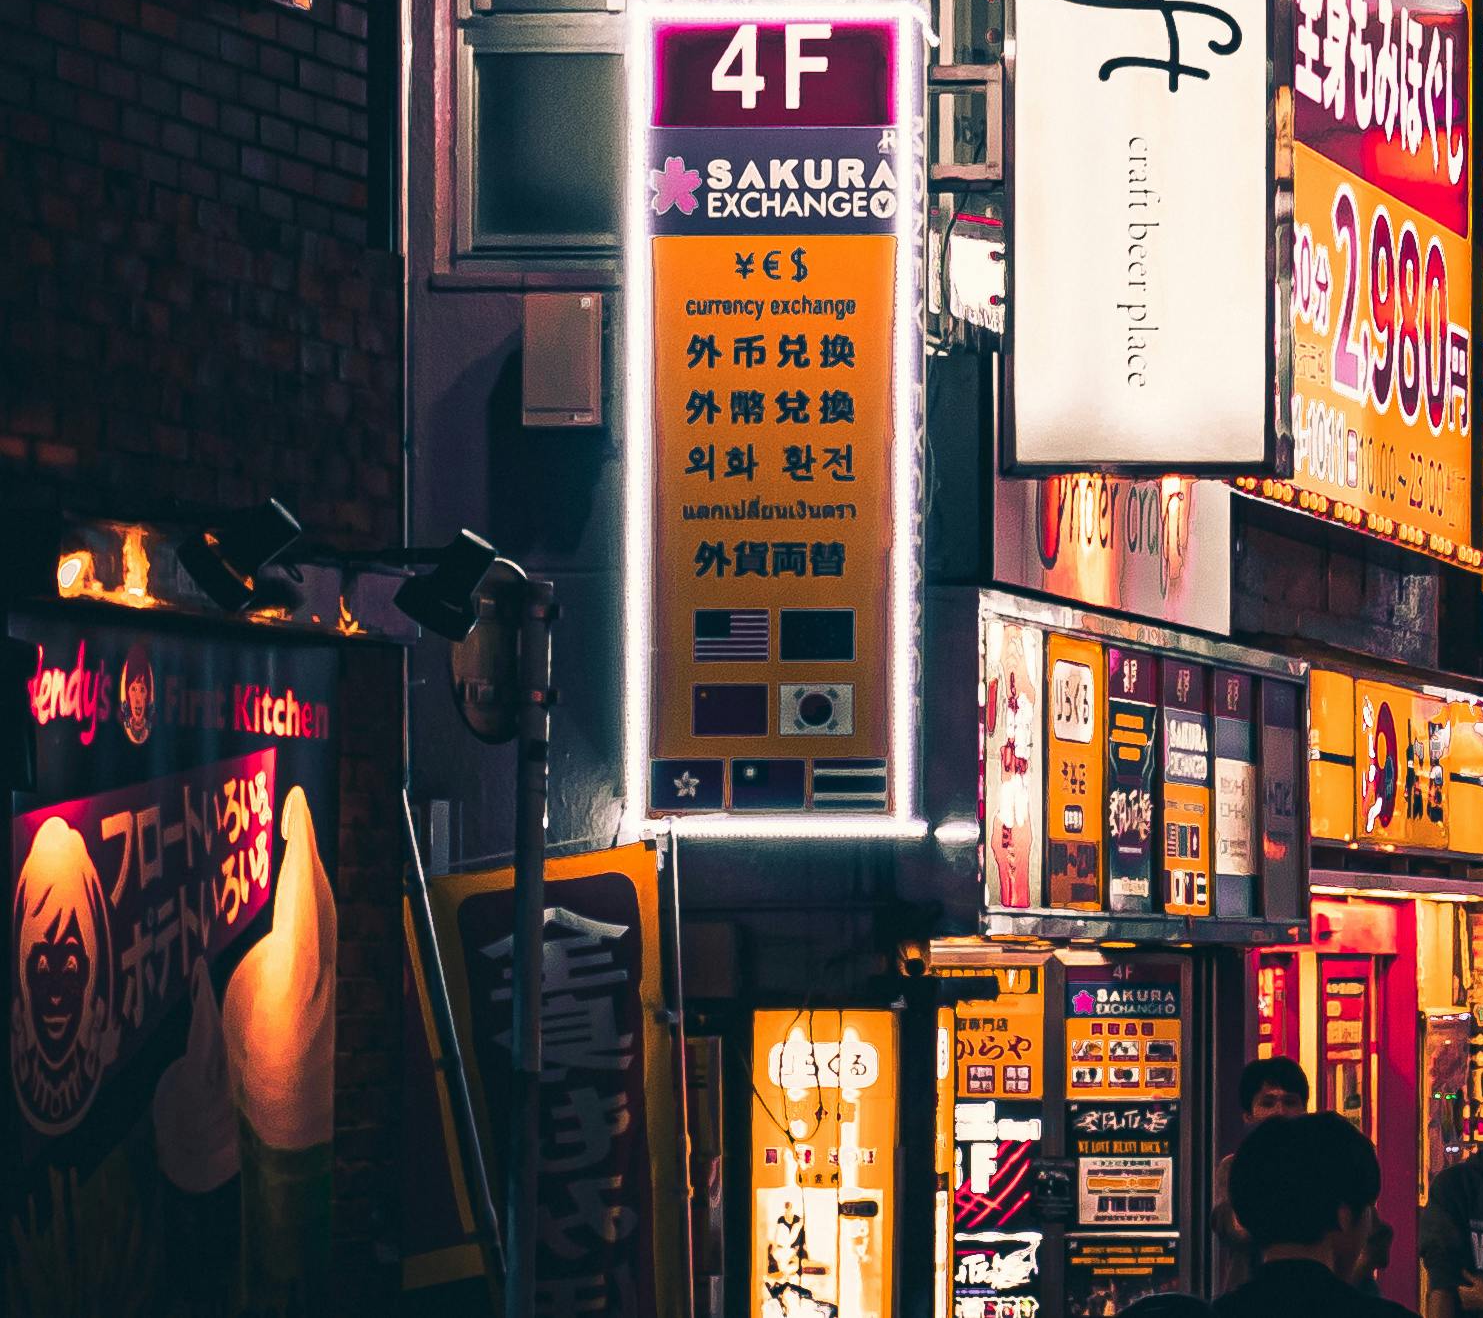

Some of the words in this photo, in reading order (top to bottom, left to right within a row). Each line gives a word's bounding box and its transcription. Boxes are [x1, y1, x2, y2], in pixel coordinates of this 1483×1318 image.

[710, 22, 833, 111] 4F
[706, 158, 898, 190] SAKURA
[1127, 136, 1163, 216] craft
[1126, 222, 1162, 294] beer
[685, 295, 765, 320] currency
[770, 294, 857, 319] exchange
[1116, 302, 1162, 390] place
[685, 445, 758, 483] 외화
[782, 445, 857, 483] 환전
[693, 541, 846, 579] 外貨両替
[231, 684, 331, 741] Kitchen
[99, 768, 273, 912] フロートいろいろ
[1096, 988, 1175, 1003] SAKURA
